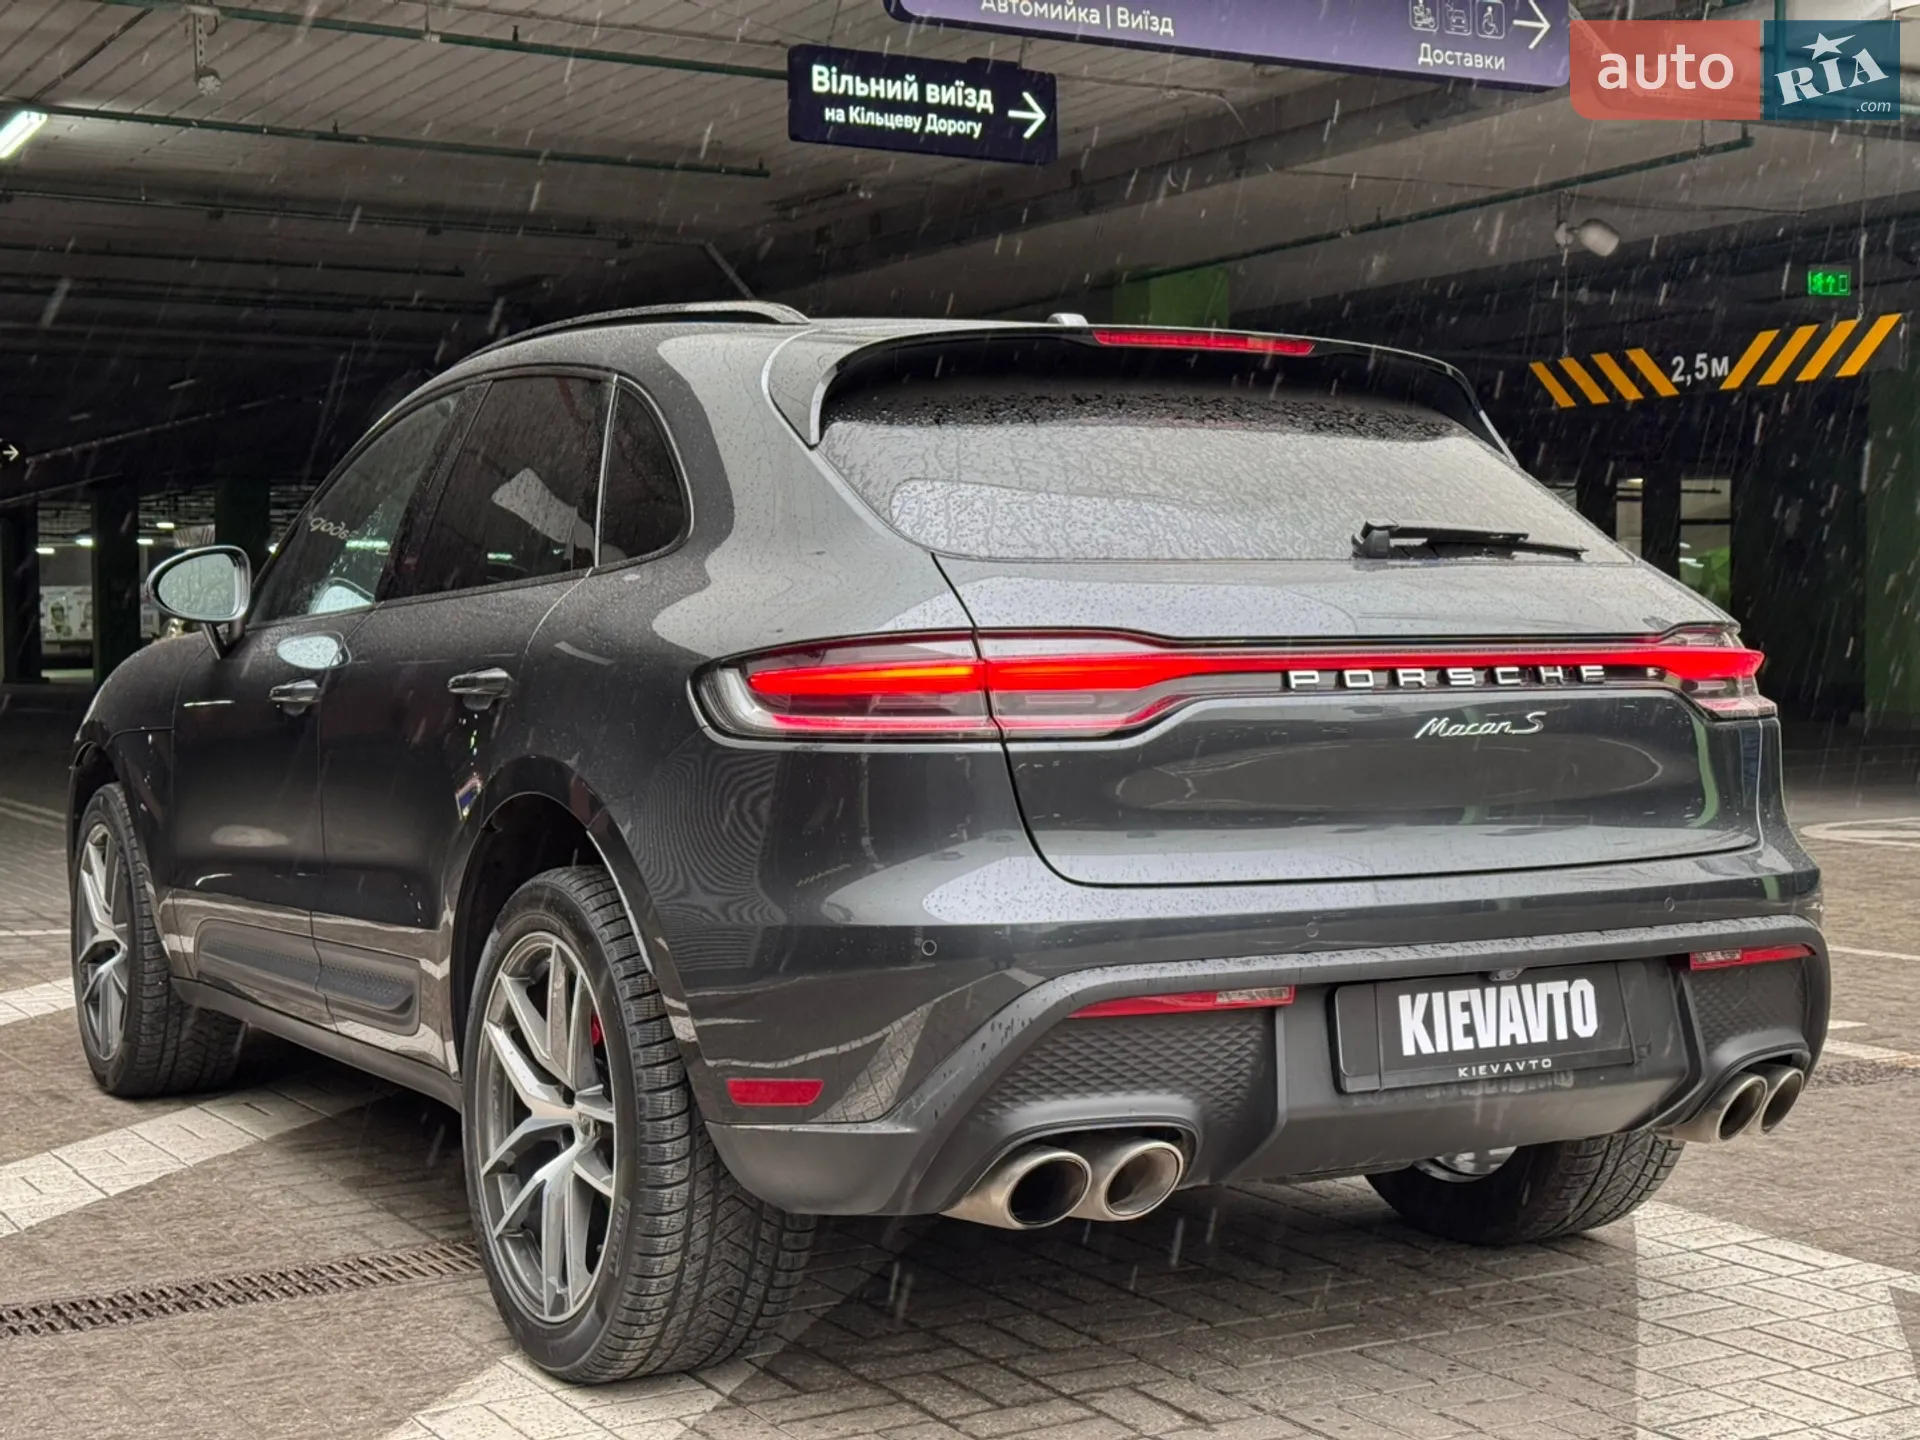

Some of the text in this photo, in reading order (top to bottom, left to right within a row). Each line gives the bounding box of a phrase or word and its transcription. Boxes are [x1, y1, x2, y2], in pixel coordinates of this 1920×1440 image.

[1116, 7, 1174, 37] Виїзд
[1418, 42, 1505, 71] Доставки
[811, 64, 994, 114] Вільний виїзд
[824, 106, 983, 139] на Кільцеву Дорогу
[1288, 664, 1605, 689] PORSCHE
[1413, 711, 1547, 739] Macan S
[1398, 978, 1599, 1057] KIEVAVTO
[1458, 1058, 1552, 1078] KIEVAVTO
